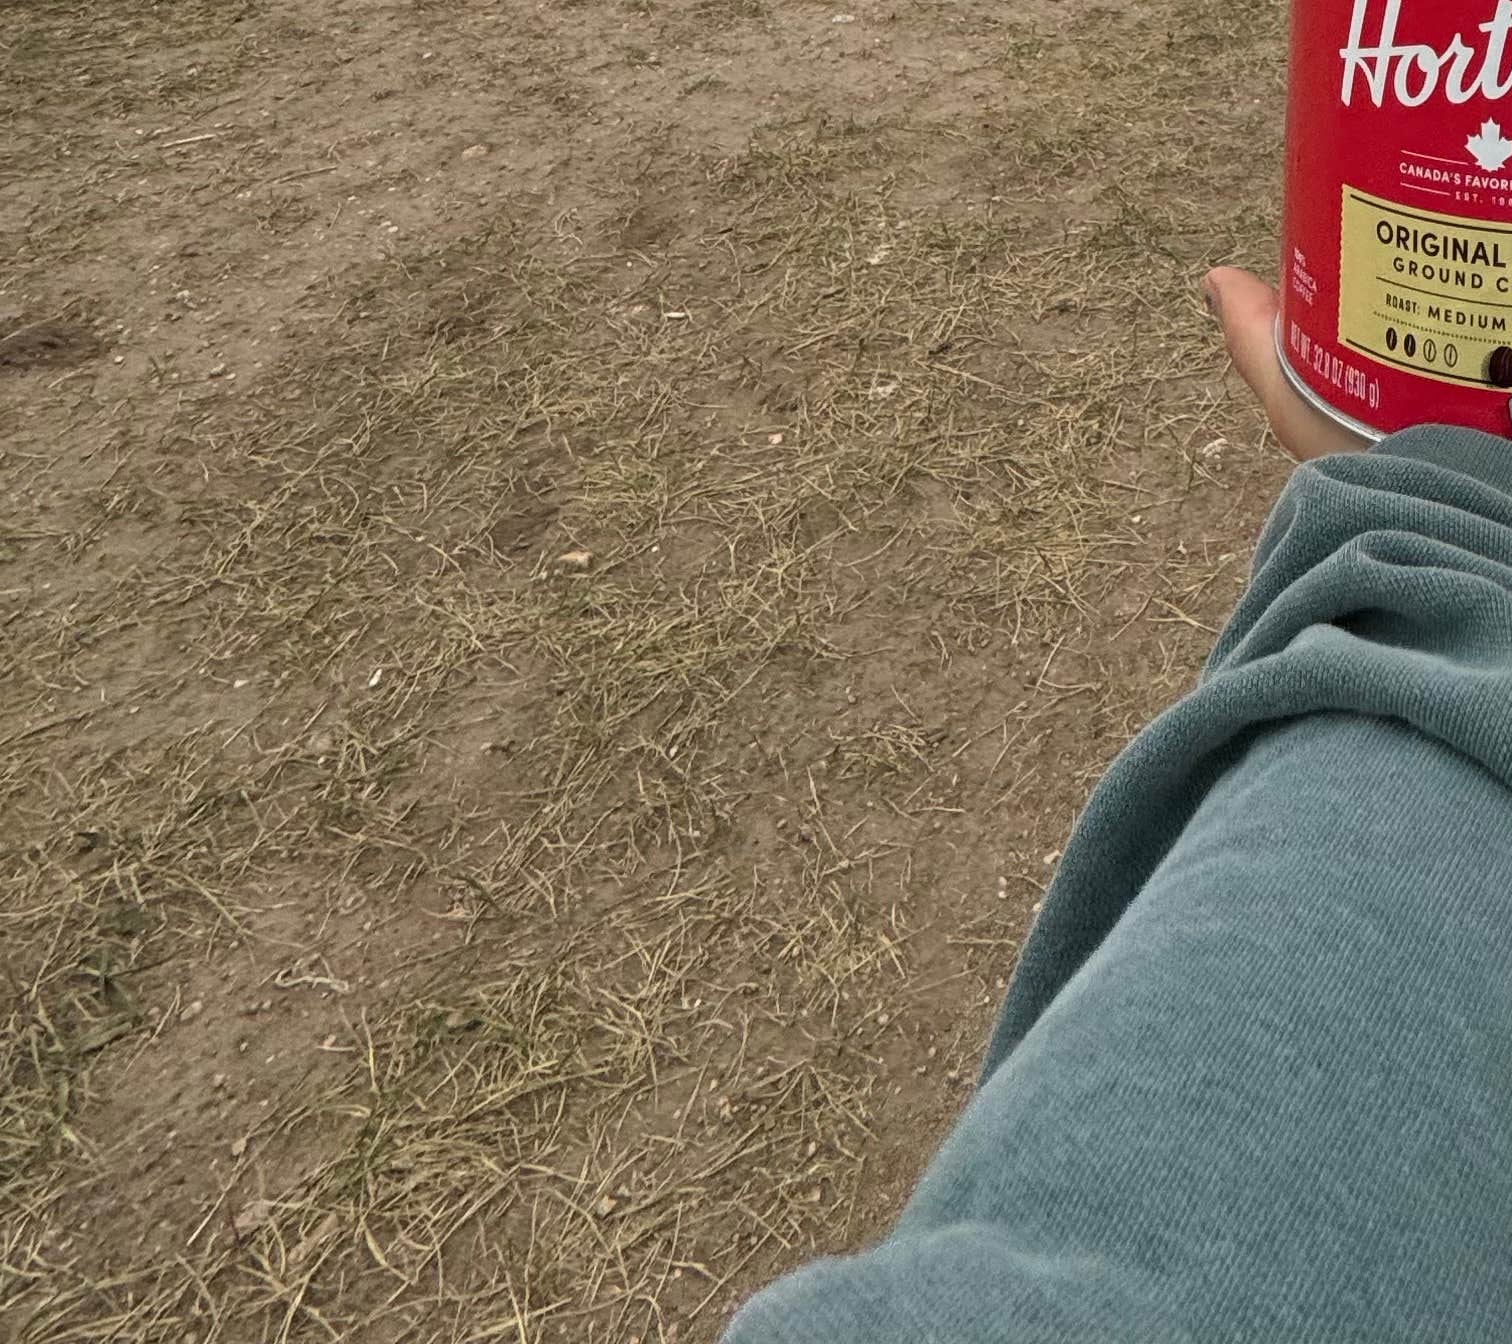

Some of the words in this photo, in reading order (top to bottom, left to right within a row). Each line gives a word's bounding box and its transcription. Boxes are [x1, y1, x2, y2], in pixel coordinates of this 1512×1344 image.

[1399, 161, 1461, 185] CANADA'S
[1455, 191, 1483, 204] EST.
[1376, 220, 1507, 268] ORIGINAL
[1393, 256, 1484, 289] GROUND
[1385, 293, 1421, 315] ROAST:
[1428, 305, 1507, 331] MEDIUM
[1313, 344, 1331, 380] 32.8
[1332, 357, 1344, 388] OZ
[1344, 365, 1366, 400] (930
[1368, 377, 1380, 410] g)
